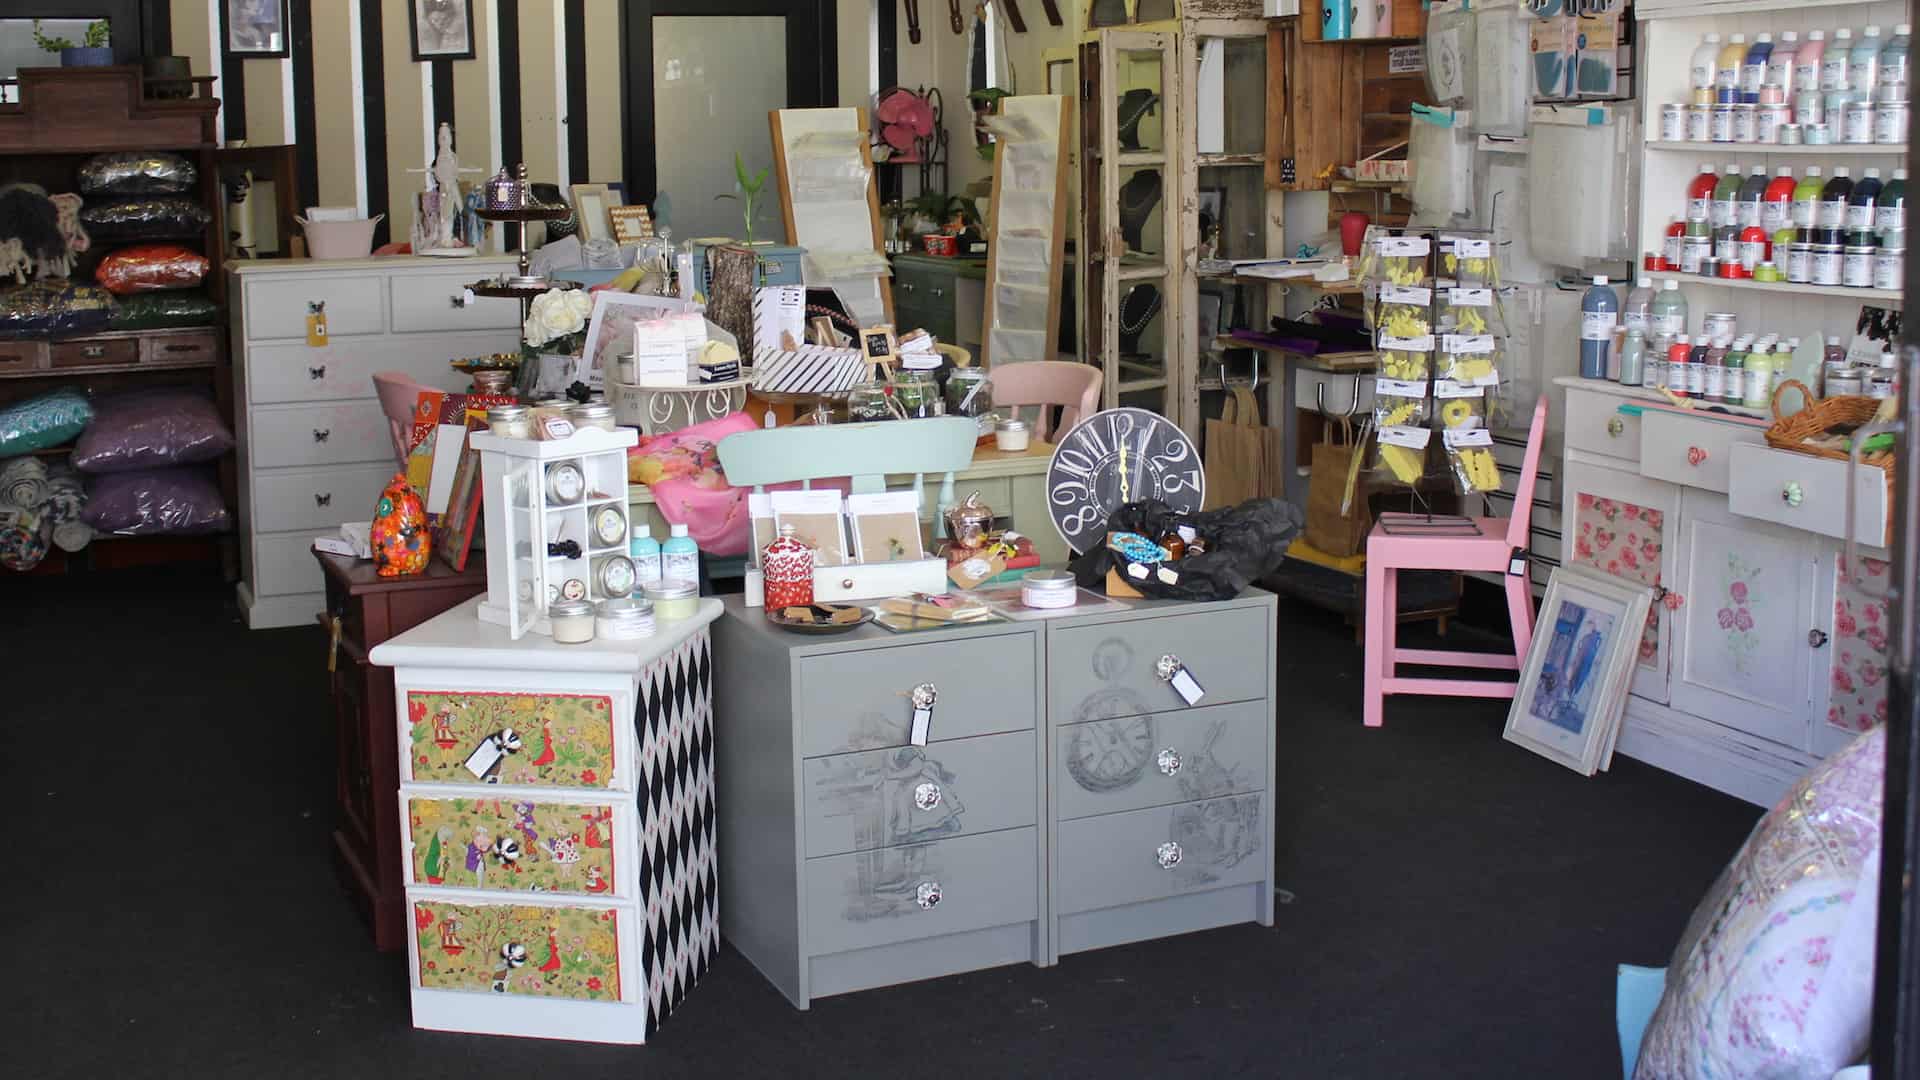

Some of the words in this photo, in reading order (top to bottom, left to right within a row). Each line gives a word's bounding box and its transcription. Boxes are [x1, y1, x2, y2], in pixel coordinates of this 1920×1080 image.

[1106, 413, 1134, 451] 12
[1054, 449, 1094, 480] 10
[1151, 439, 1188, 472] 2
[1052, 481, 1089, 505] 9
[1162, 470, 1200, 493] 3
[1062, 505, 1097, 536] 8
